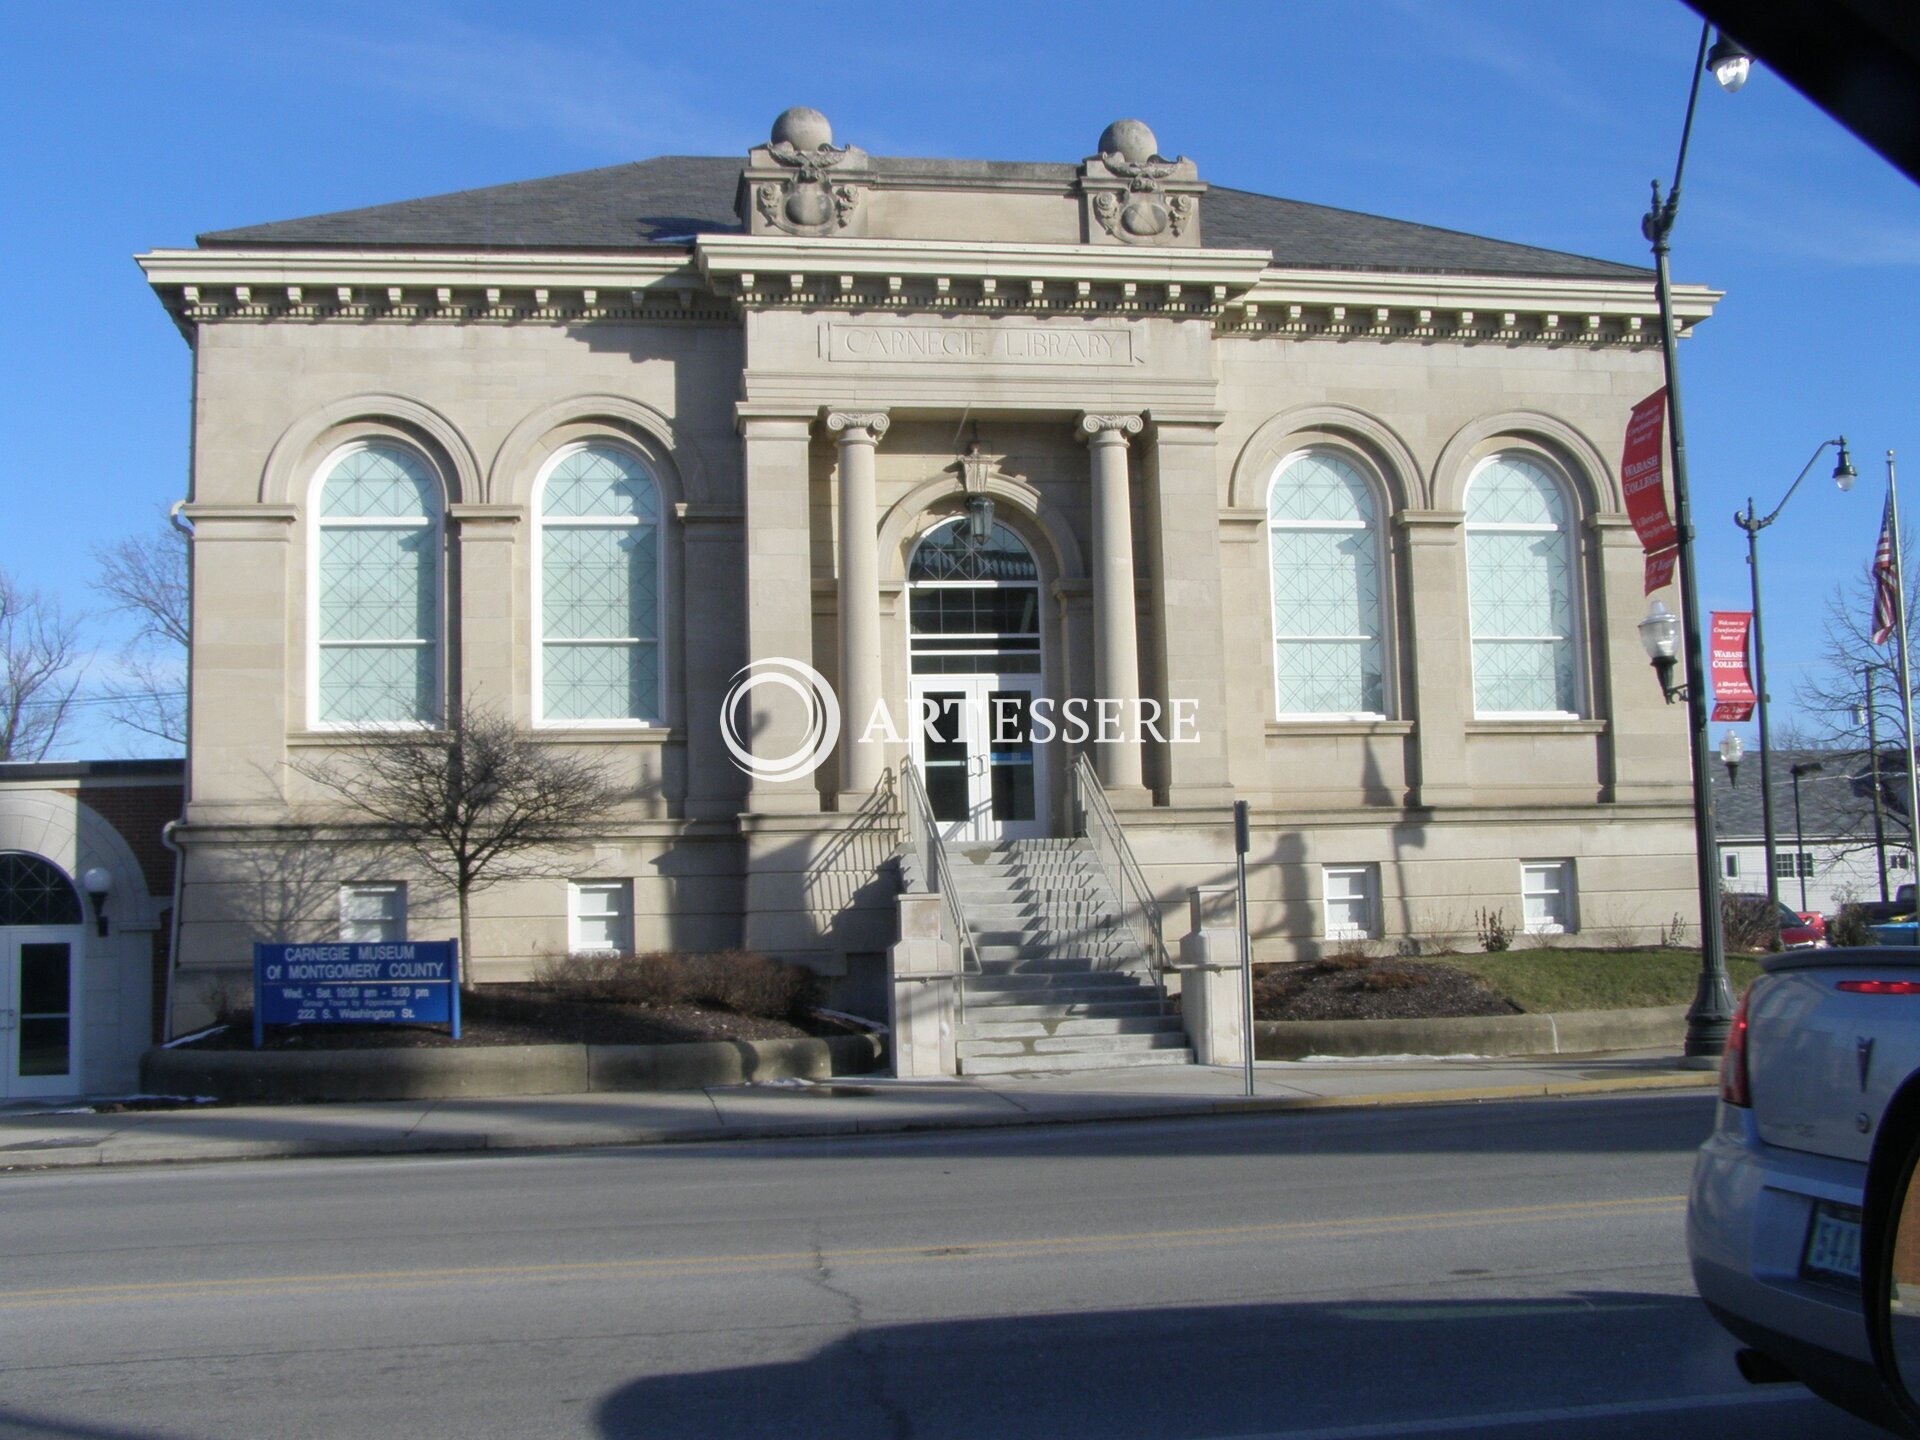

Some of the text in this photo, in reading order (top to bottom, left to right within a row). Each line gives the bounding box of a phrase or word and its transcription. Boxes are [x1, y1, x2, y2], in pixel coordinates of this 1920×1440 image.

[844, 328, 1120, 359] CARNEGIE LIBRARY
[1624, 454, 1659, 478] WABASH
[1624, 471, 1662, 496] COLLEGE
[1713, 650, 1745, 658] WABASH
[1712, 660, 1748, 669] COLLEGE
[284, 945, 415, 962] CARNEGIE MUSEUM
[289, 963, 381, 979] MONTGOMERY
[389, 962, 443, 978] COUNTY
[363, 989, 378, 998] am
[391, 987, 411, 998] 5:00
[415, 988, 430, 999] pm
[297, 1008, 416, 1020] 222 S. Washington St.
